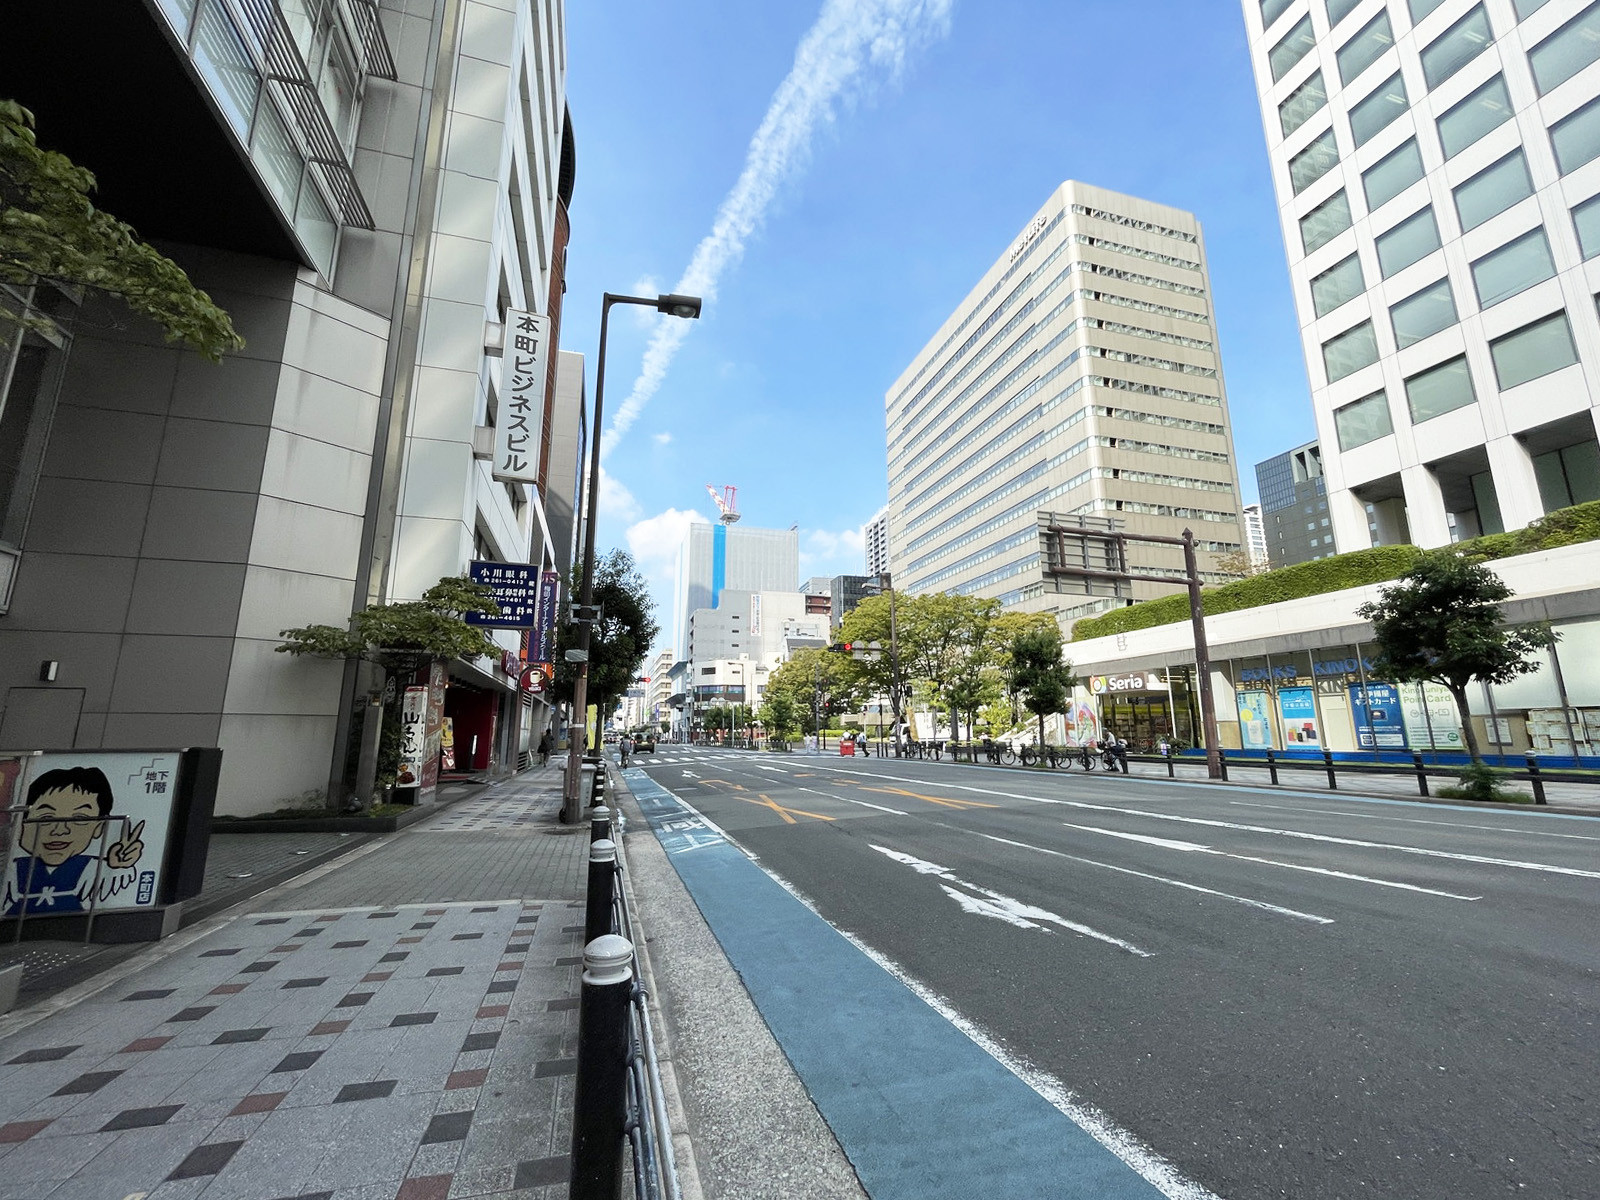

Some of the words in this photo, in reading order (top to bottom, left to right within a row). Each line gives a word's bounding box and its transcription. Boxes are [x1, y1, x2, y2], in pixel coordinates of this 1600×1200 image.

[1009, 215, 1047, 263] MetLife
[502, 316, 540, 472] 本町ビジネスビル
[480, 568, 528, 579] 小川眼科
[1109, 674, 1143, 691] Seria
[1427, 694, 1452, 703] Card
[145, 770, 169, 781] 地下
[144, 781, 167, 794] 1階
[138, 874, 154, 903] 本町店
